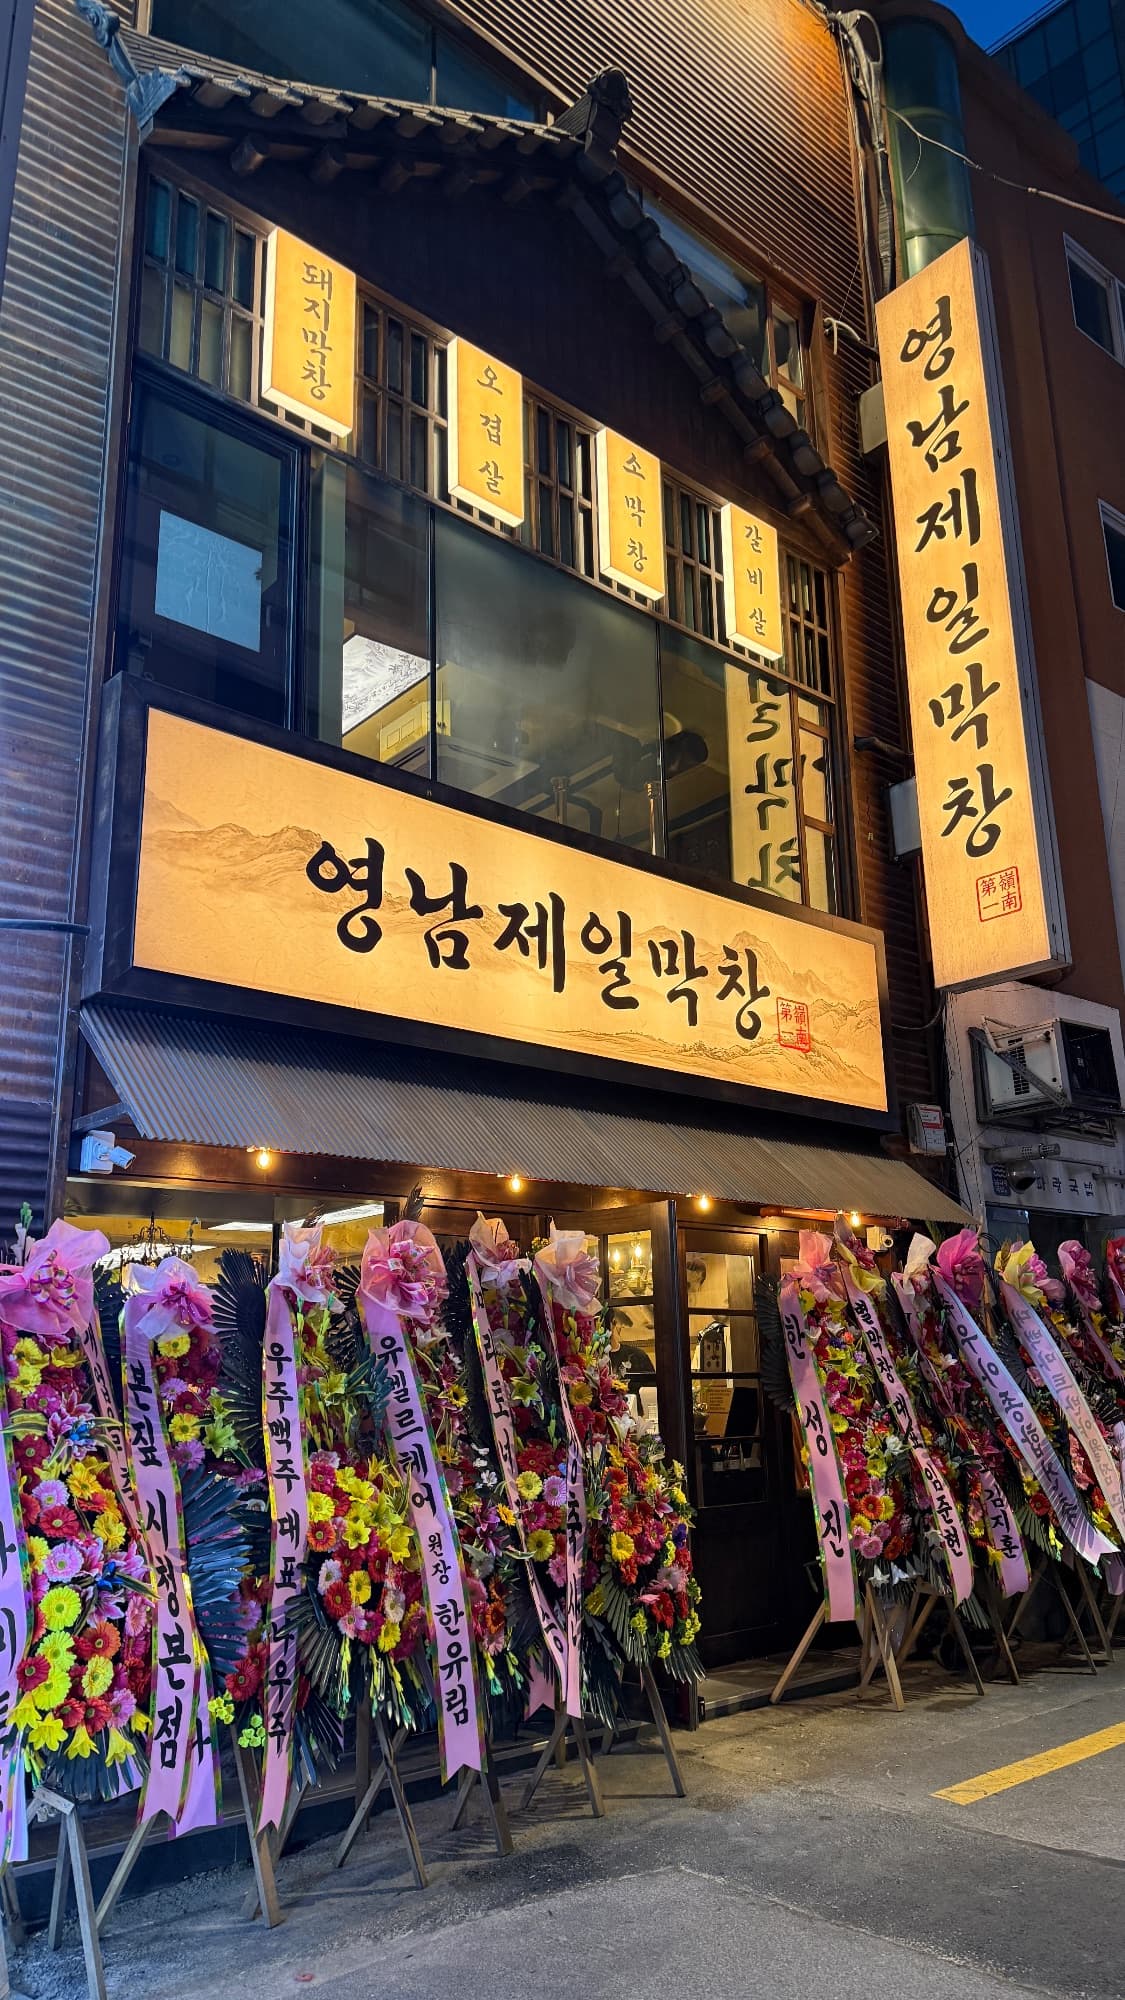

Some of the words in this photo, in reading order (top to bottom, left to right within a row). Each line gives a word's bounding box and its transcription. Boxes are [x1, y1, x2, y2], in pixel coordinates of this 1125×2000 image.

[301, 261, 333, 401] 돼지막창
[476, 364, 504, 496] 오겹살
[622, 453, 648, 574] 소막창
[899, 295, 1013, 858] 영남제일막창
[743, 524, 767, 637] 갈비살
[305, 836, 772, 1041] 영남제일막창
[265, 1342, 301, 1496] 우주맥주
[275, 1510, 302, 1590] 대표
[427, 1532, 450, 1586] 원장
[924, 1465, 962, 1558] 임준현
[984, 1485, 1020, 1562] 김지훈
[146, 1489, 194, 1769] 시청본점
[435, 1597, 470, 1728] 한유림
